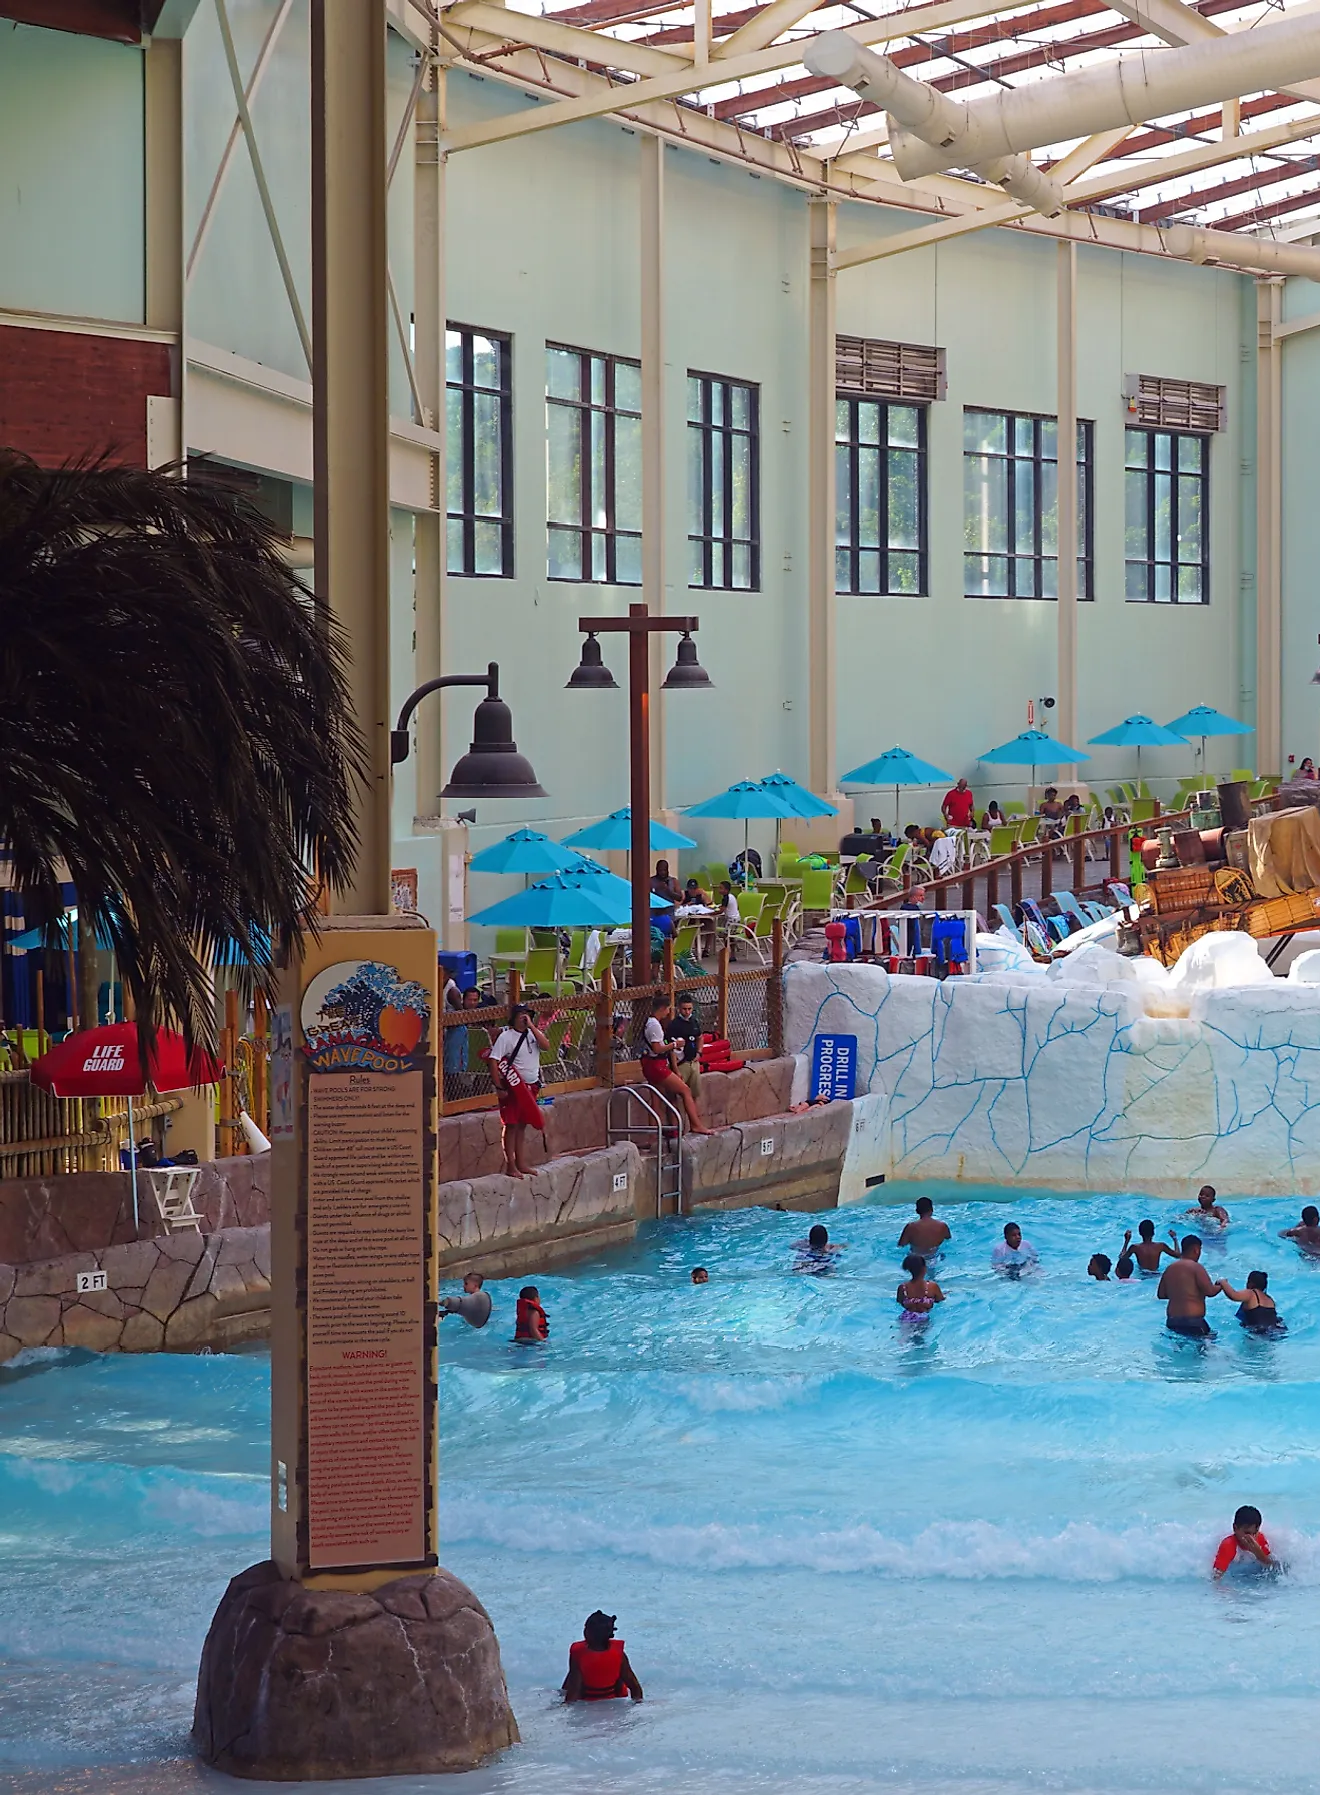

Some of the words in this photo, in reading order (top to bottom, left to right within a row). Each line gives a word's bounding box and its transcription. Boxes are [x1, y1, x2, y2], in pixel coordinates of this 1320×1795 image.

[92, 1044, 124, 1058] LIFE
[301, 1031, 411, 1057] KANAGAWA
[82, 1058, 125, 1072] GUARD
[818, 1039, 834, 1100] PROGRES
[836, 1048, 850, 1082] DRILL
[350, 1075, 371, 1084] Rules
[498, 1058, 522, 1087] GUARD
[834, 1084, 848, 1098] IN
[767, 1141, 772, 1152] FT
[614, 1176, 619, 1186] 4
[620, 1176, 626, 1187] FT
[82, 1276, 88, 1290] 2
[94, 1274, 105, 1288] FT
[342, 1350, 388, 1360] WARNING!
